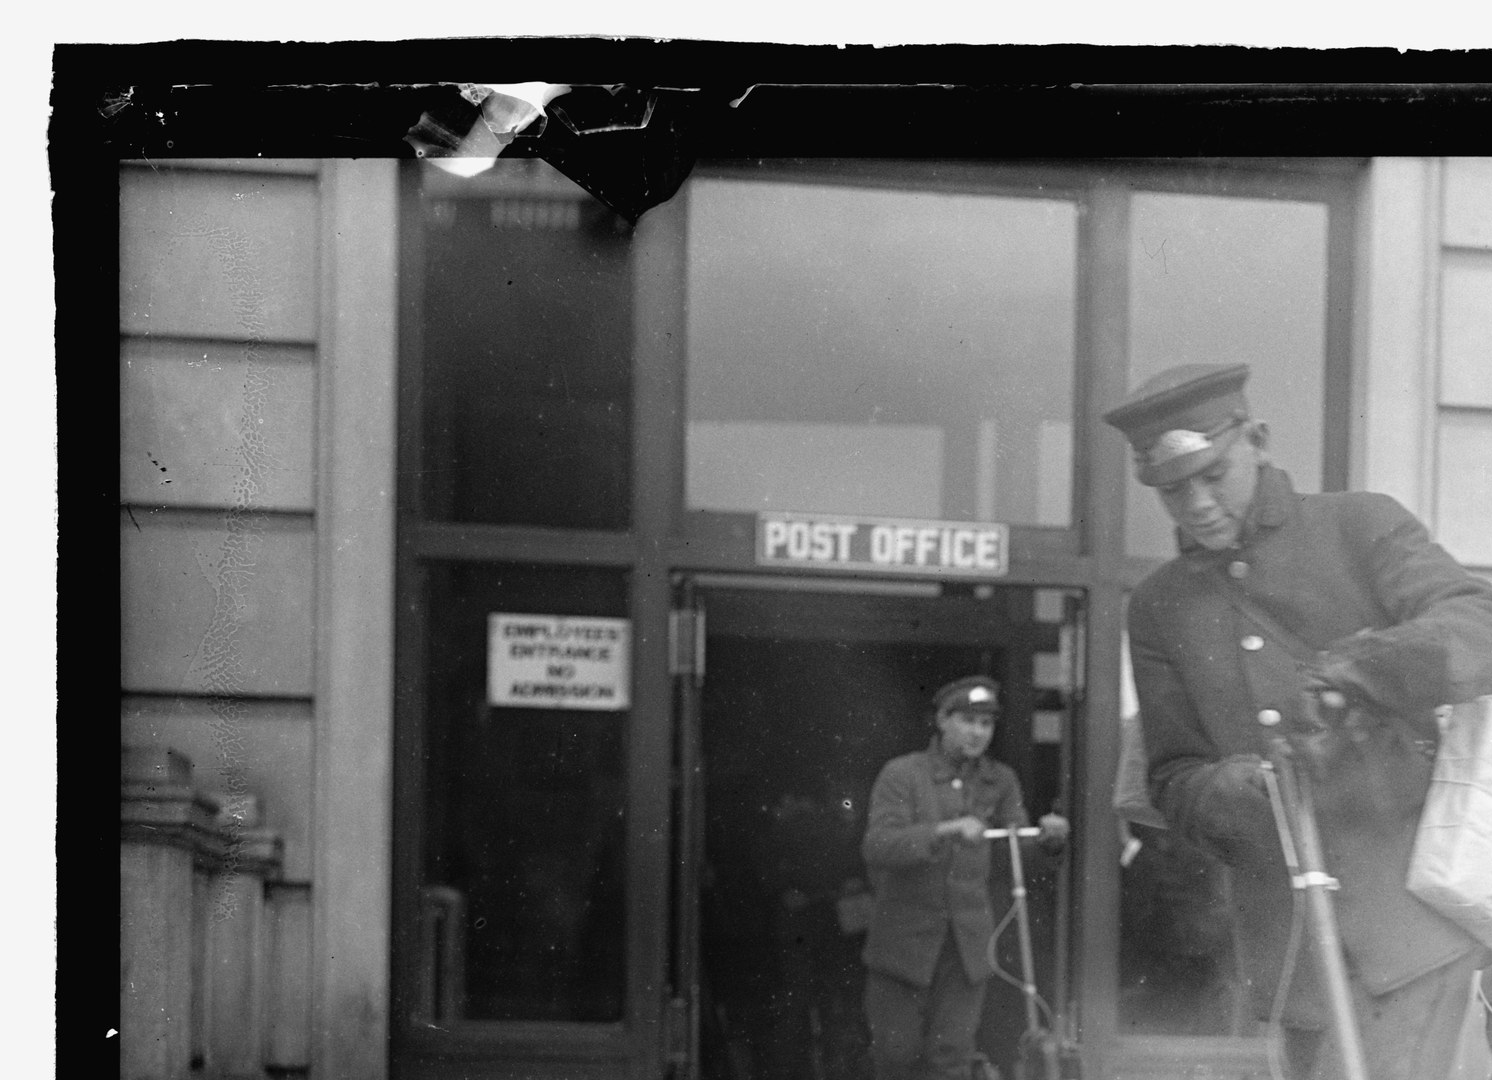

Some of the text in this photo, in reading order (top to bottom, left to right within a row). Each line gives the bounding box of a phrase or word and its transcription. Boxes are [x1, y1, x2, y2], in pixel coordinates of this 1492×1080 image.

[765, 521, 1000, 569] POST OFFICE
[509, 643, 610, 662] ENTRANCE
[546, 664, 576, 680] NO
[509, 682, 615, 699] ADMISSION
